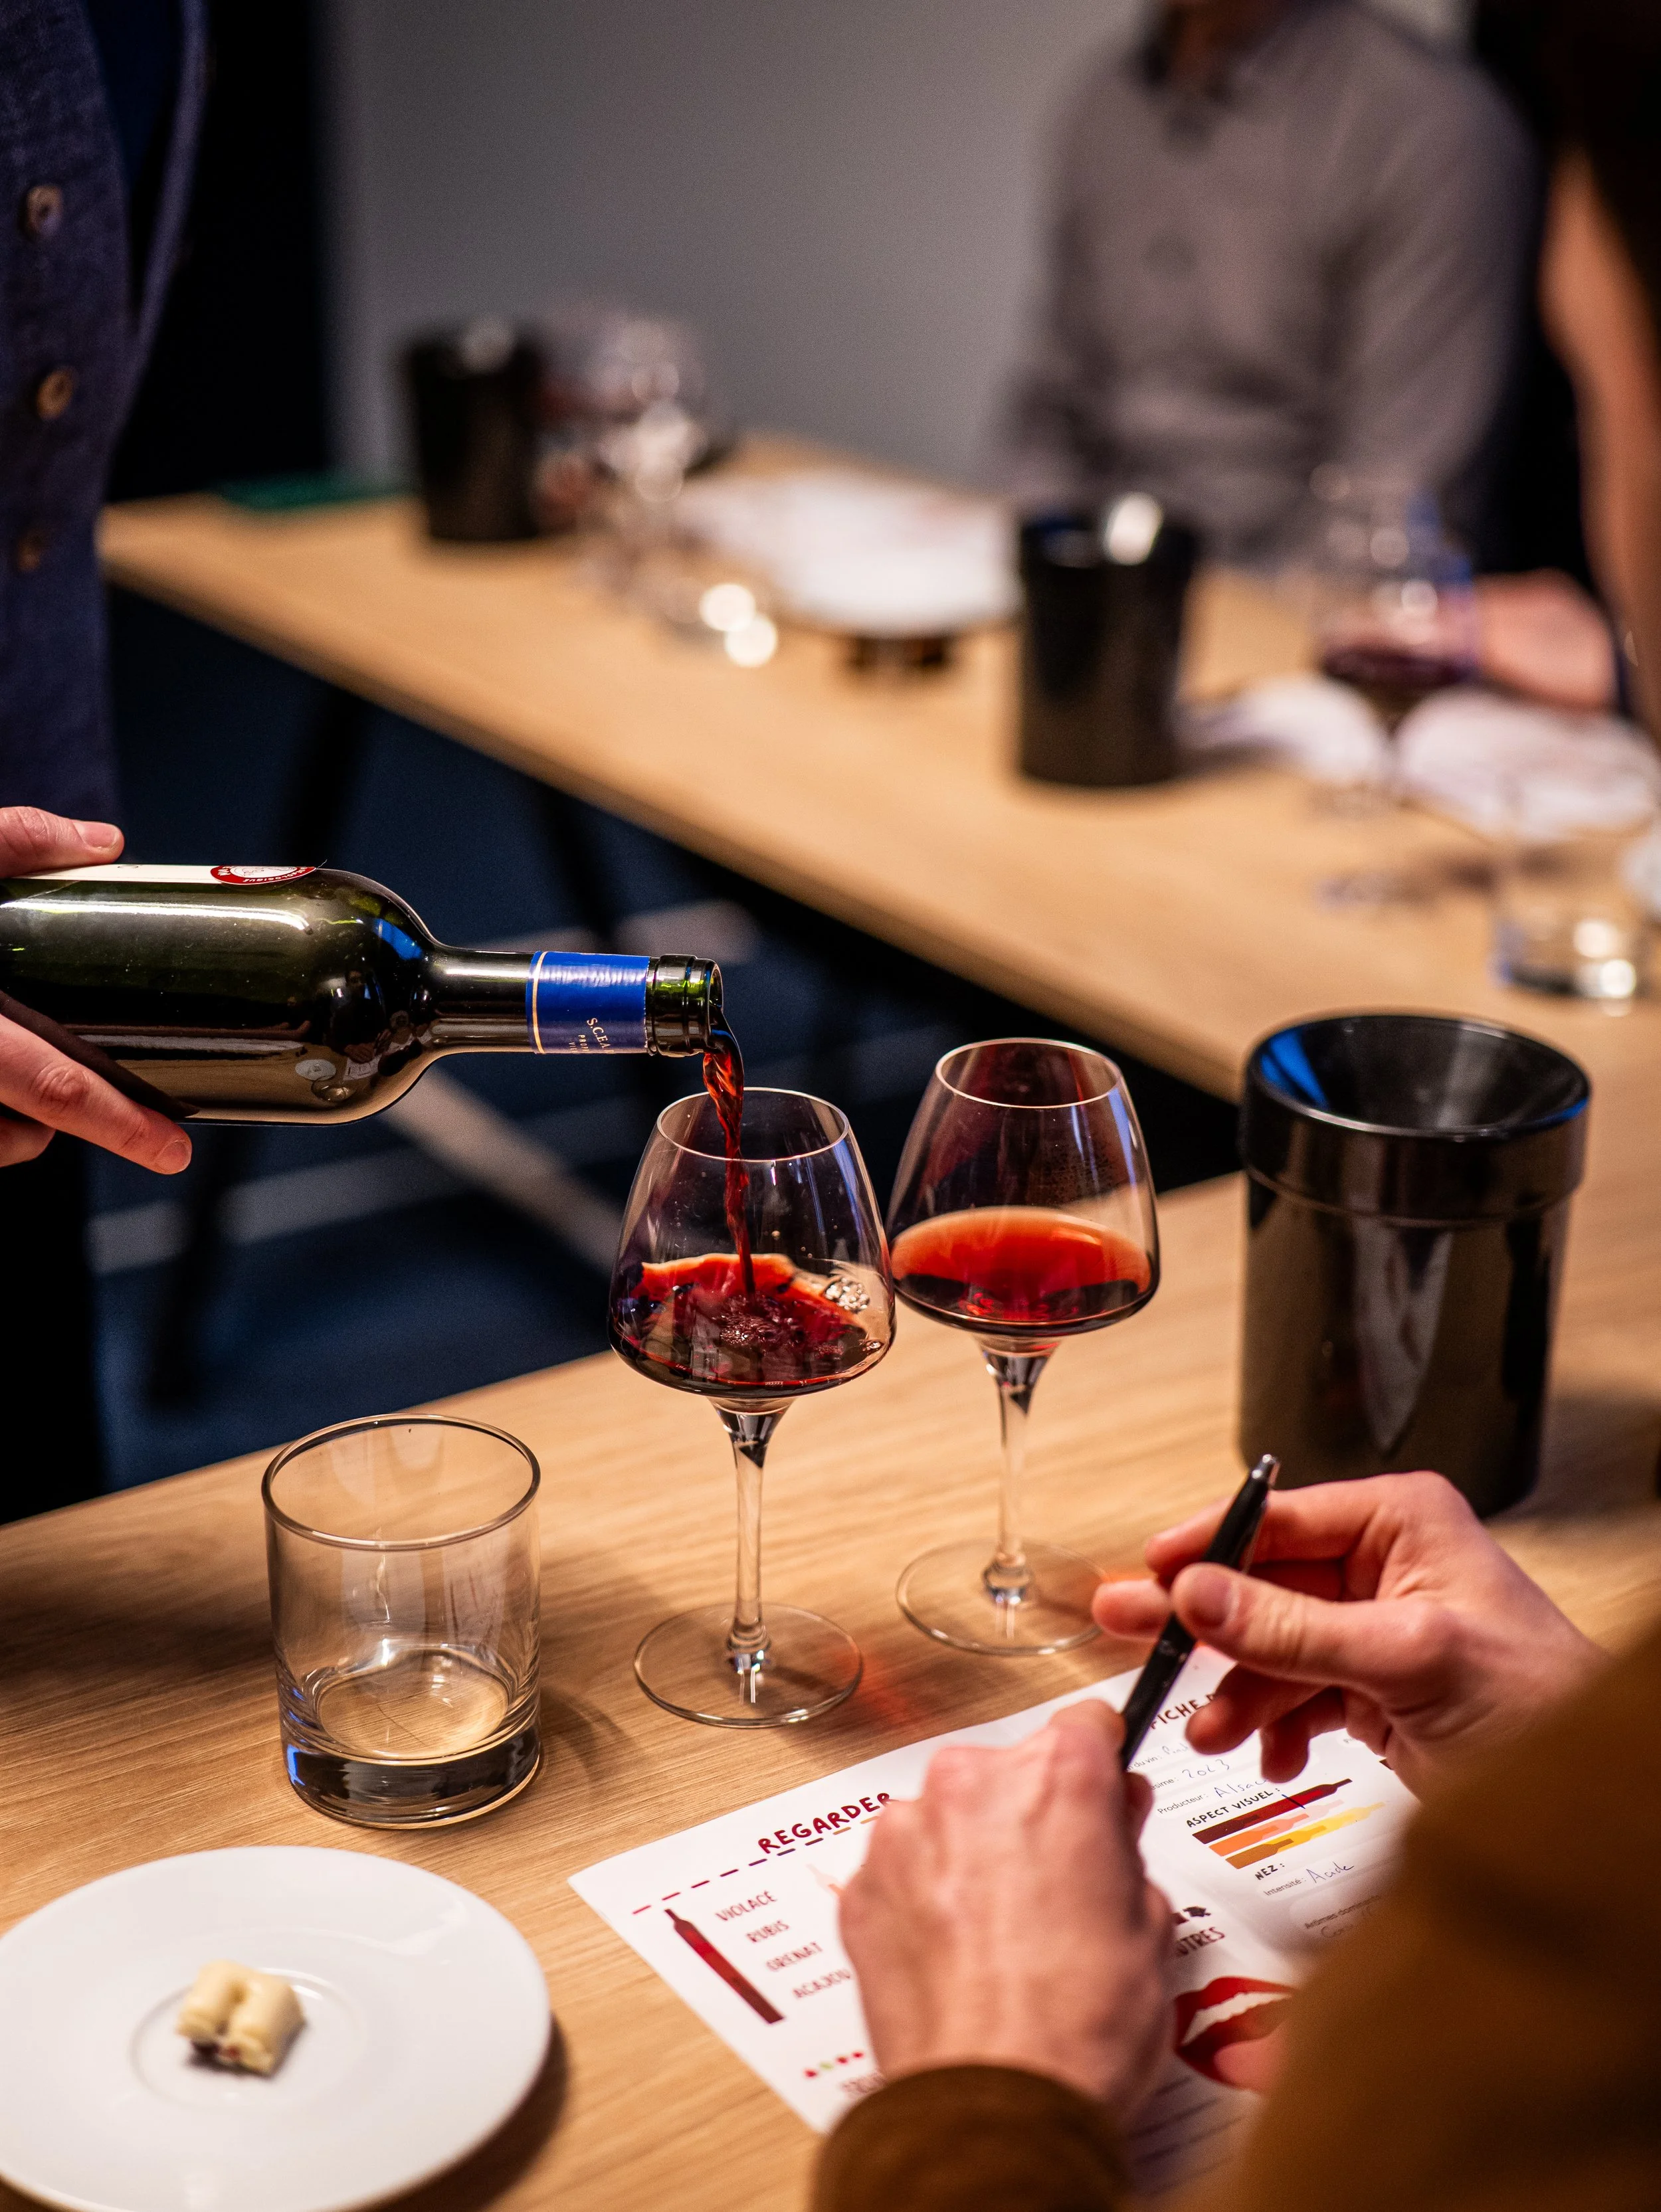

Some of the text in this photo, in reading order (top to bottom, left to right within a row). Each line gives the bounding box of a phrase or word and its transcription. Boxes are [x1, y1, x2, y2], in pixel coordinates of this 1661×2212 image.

[1157, 1794, 1205, 1814] Producteur
[1186, 1806, 1229, 1828] ASPECT
[1232, 1790, 1274, 1810] VISUEL
[758, 1792, 898, 1854] REGARDER
[1254, 1864, 1278, 1881] NEZ
[1264, 1877, 1302, 1896] Intensité
